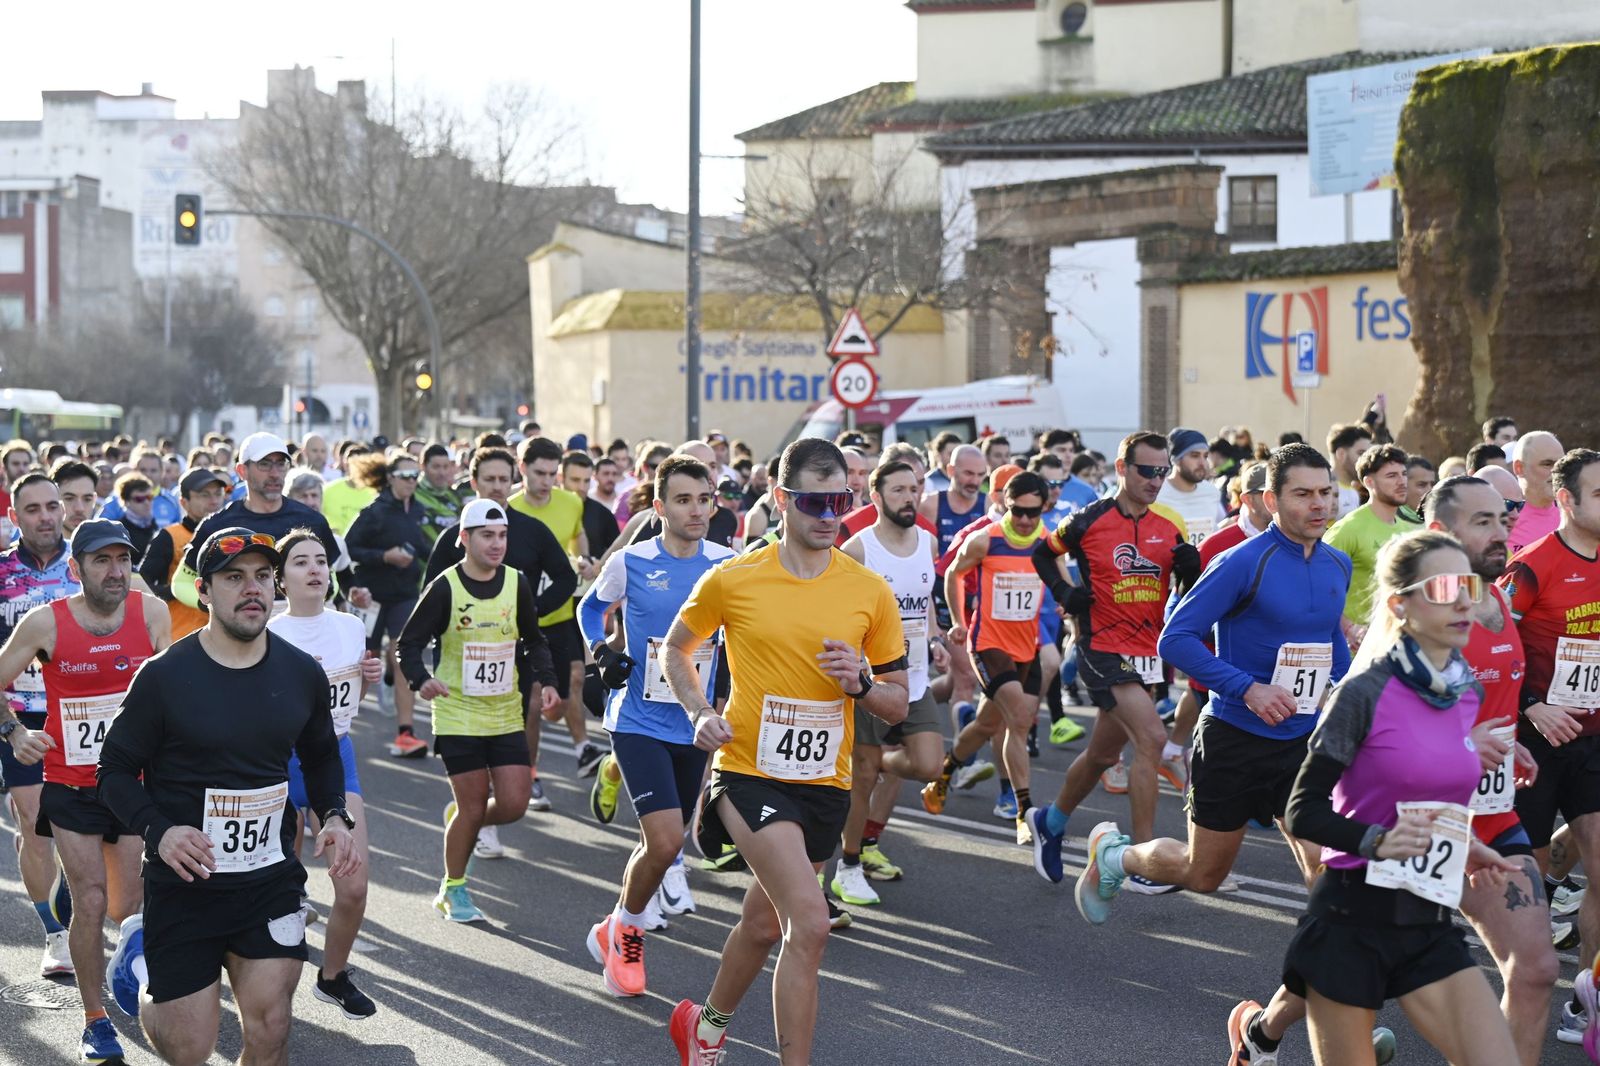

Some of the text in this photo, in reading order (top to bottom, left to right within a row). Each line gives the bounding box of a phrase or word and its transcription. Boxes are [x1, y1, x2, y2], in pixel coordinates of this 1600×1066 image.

[1299, 335, 1313, 359] P
[842, 376, 867, 392] 20
[1004, 591, 1033, 610] 112
[475, 661, 506, 684] 437
[1293, 669, 1317, 697] 51
[1566, 664, 1600, 692] 418
[766, 700, 797, 727] XLII
[776, 728, 829, 762] 483
[210, 795, 241, 817] XLII
[223, 816, 271, 853] 354
